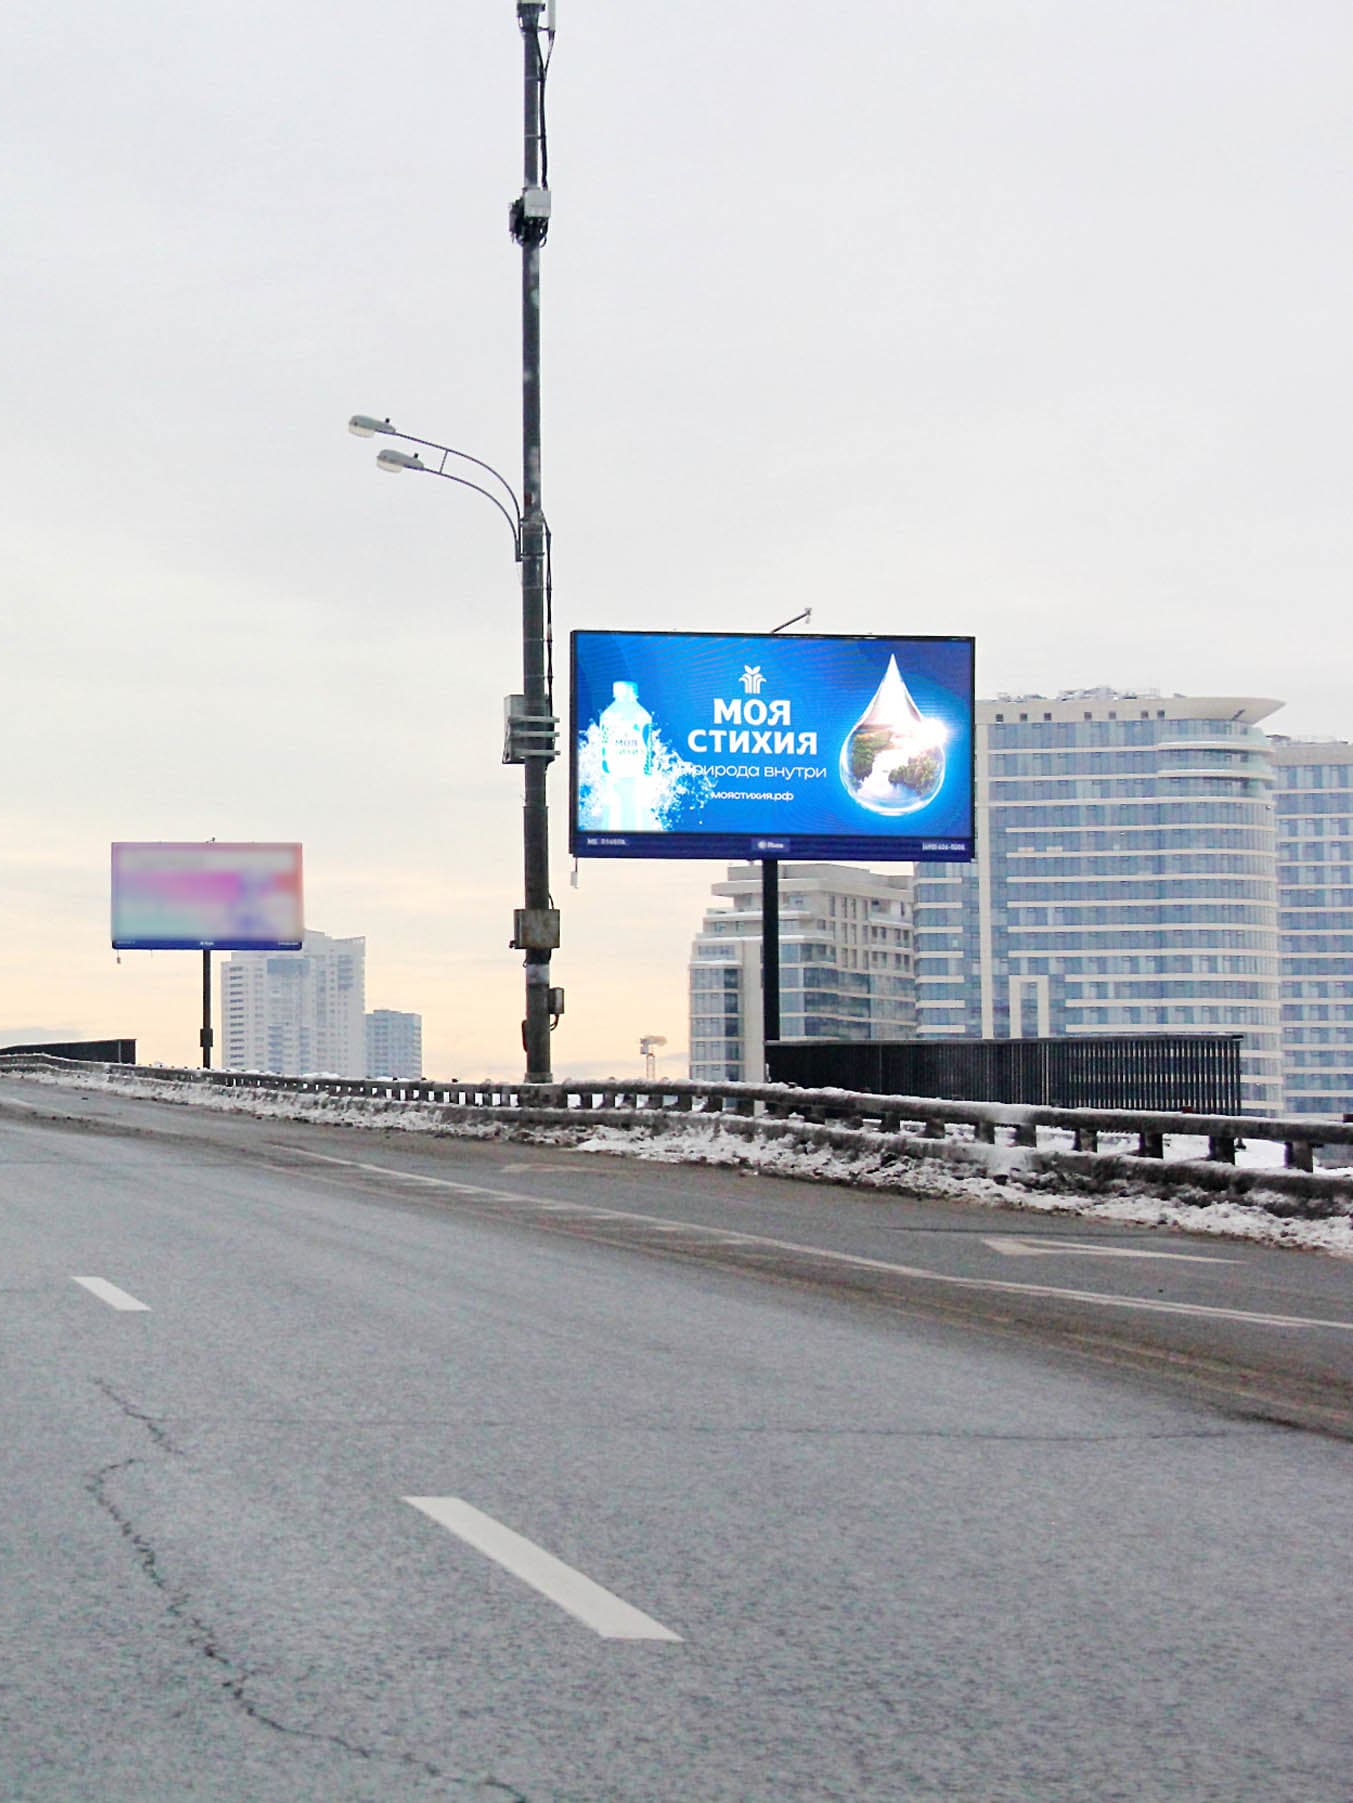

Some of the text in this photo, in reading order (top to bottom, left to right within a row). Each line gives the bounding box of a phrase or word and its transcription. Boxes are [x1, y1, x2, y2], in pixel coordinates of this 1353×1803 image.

[713, 698, 791, 726] МОЯ
[687, 729, 818, 755] СТИХИЯ
[682, 763, 828, 781] рирода внутри
